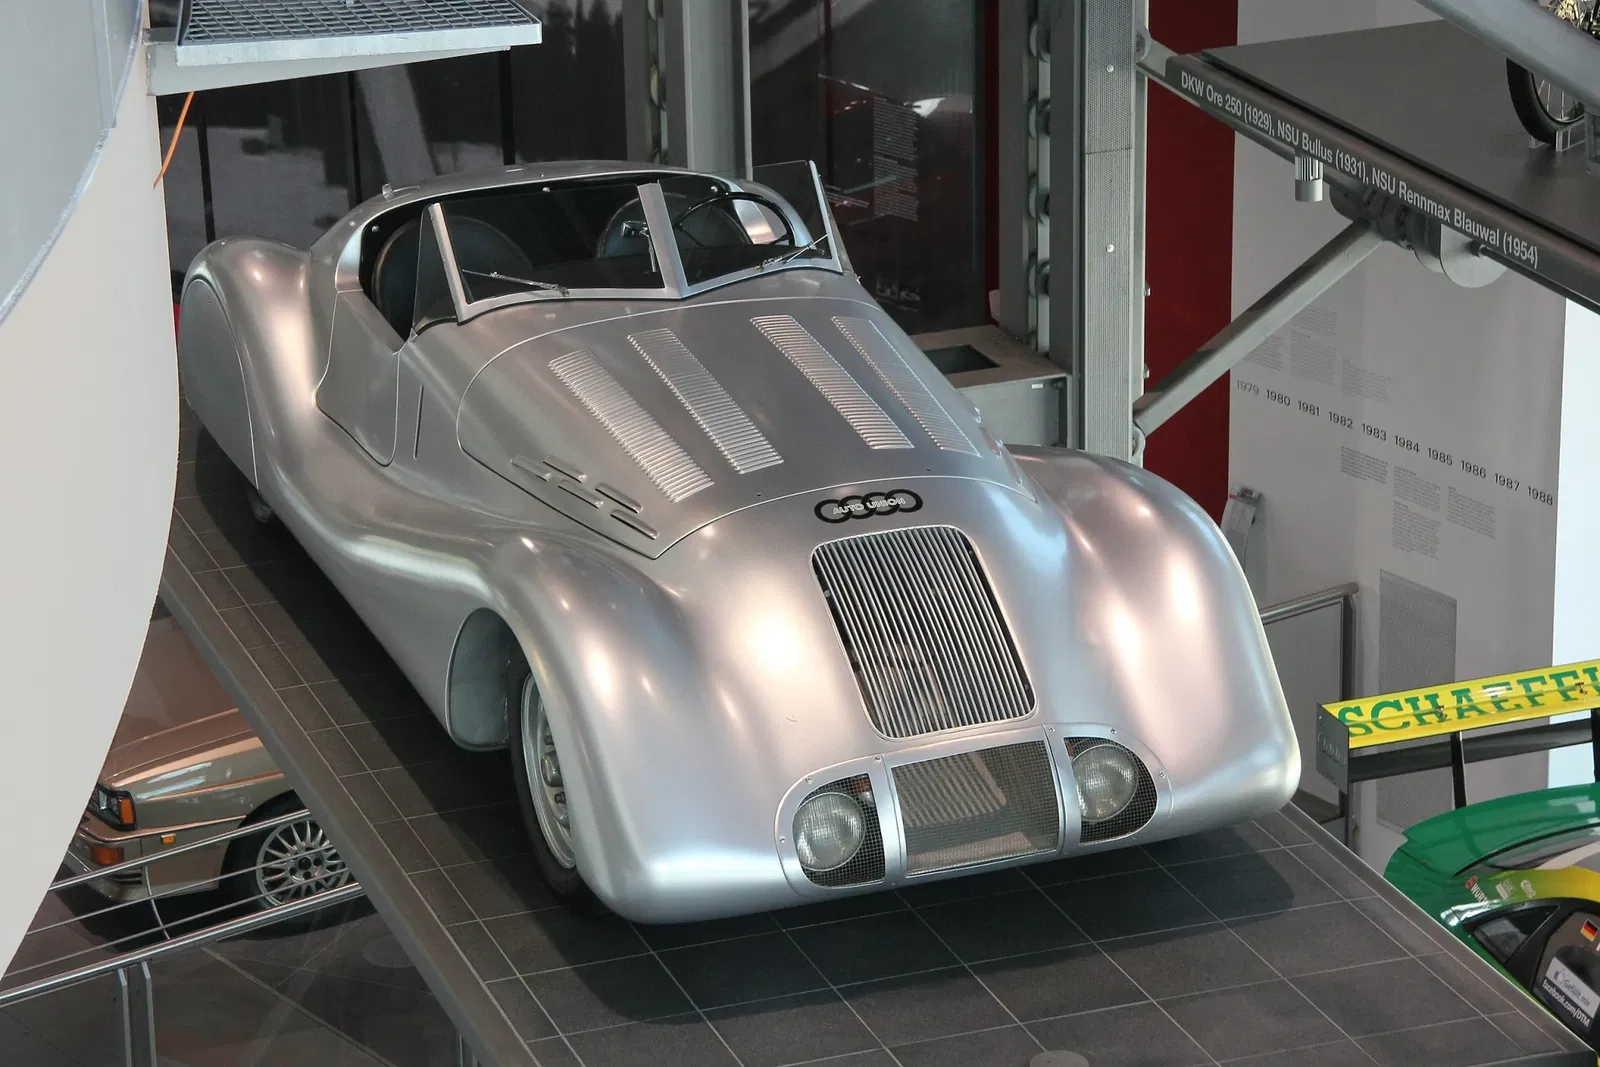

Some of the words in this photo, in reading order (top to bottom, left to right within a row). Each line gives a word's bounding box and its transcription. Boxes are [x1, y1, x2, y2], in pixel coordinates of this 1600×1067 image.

[1181, 71, 1204, 97] DKW
[1206, 84, 1223, 107] Ore
[1225, 94, 1242, 116] 250
[1244, 102, 1275, 137] (1929),
[1277, 119, 1299, 146] NSU
[1302, 132, 1333, 163] Bullus
[1335, 149, 1369, 185] (1931),
[1372, 167, 1396, 194] NSU
[1399, 180, 1451, 223] Rennmax
[1454, 207, 1500, 247] Blauwal
[1503, 231, 1539, 269] (1954)
[1236, 379, 1260, 396] 1979
[1265, 389, 1291, 407] 1980
[1298, 400, 1320, 417] 1981
[1328, 411, 1354, 429] 1982
[1362, 423, 1387, 442] 1983
[1394, 435, 1420, 453] 1984
[1427, 447, 1453, 466] 1985
[1460, 460, 1487, 479] 1986
[1494, 473, 1520, 491] 1987
[1527, 486, 1554, 506] 1988
[832, 503, 865, 515] AUTO
[865, 497, 906, 509] UNION
[1542, 979, 1591, 1028] facebook.com/DTM
